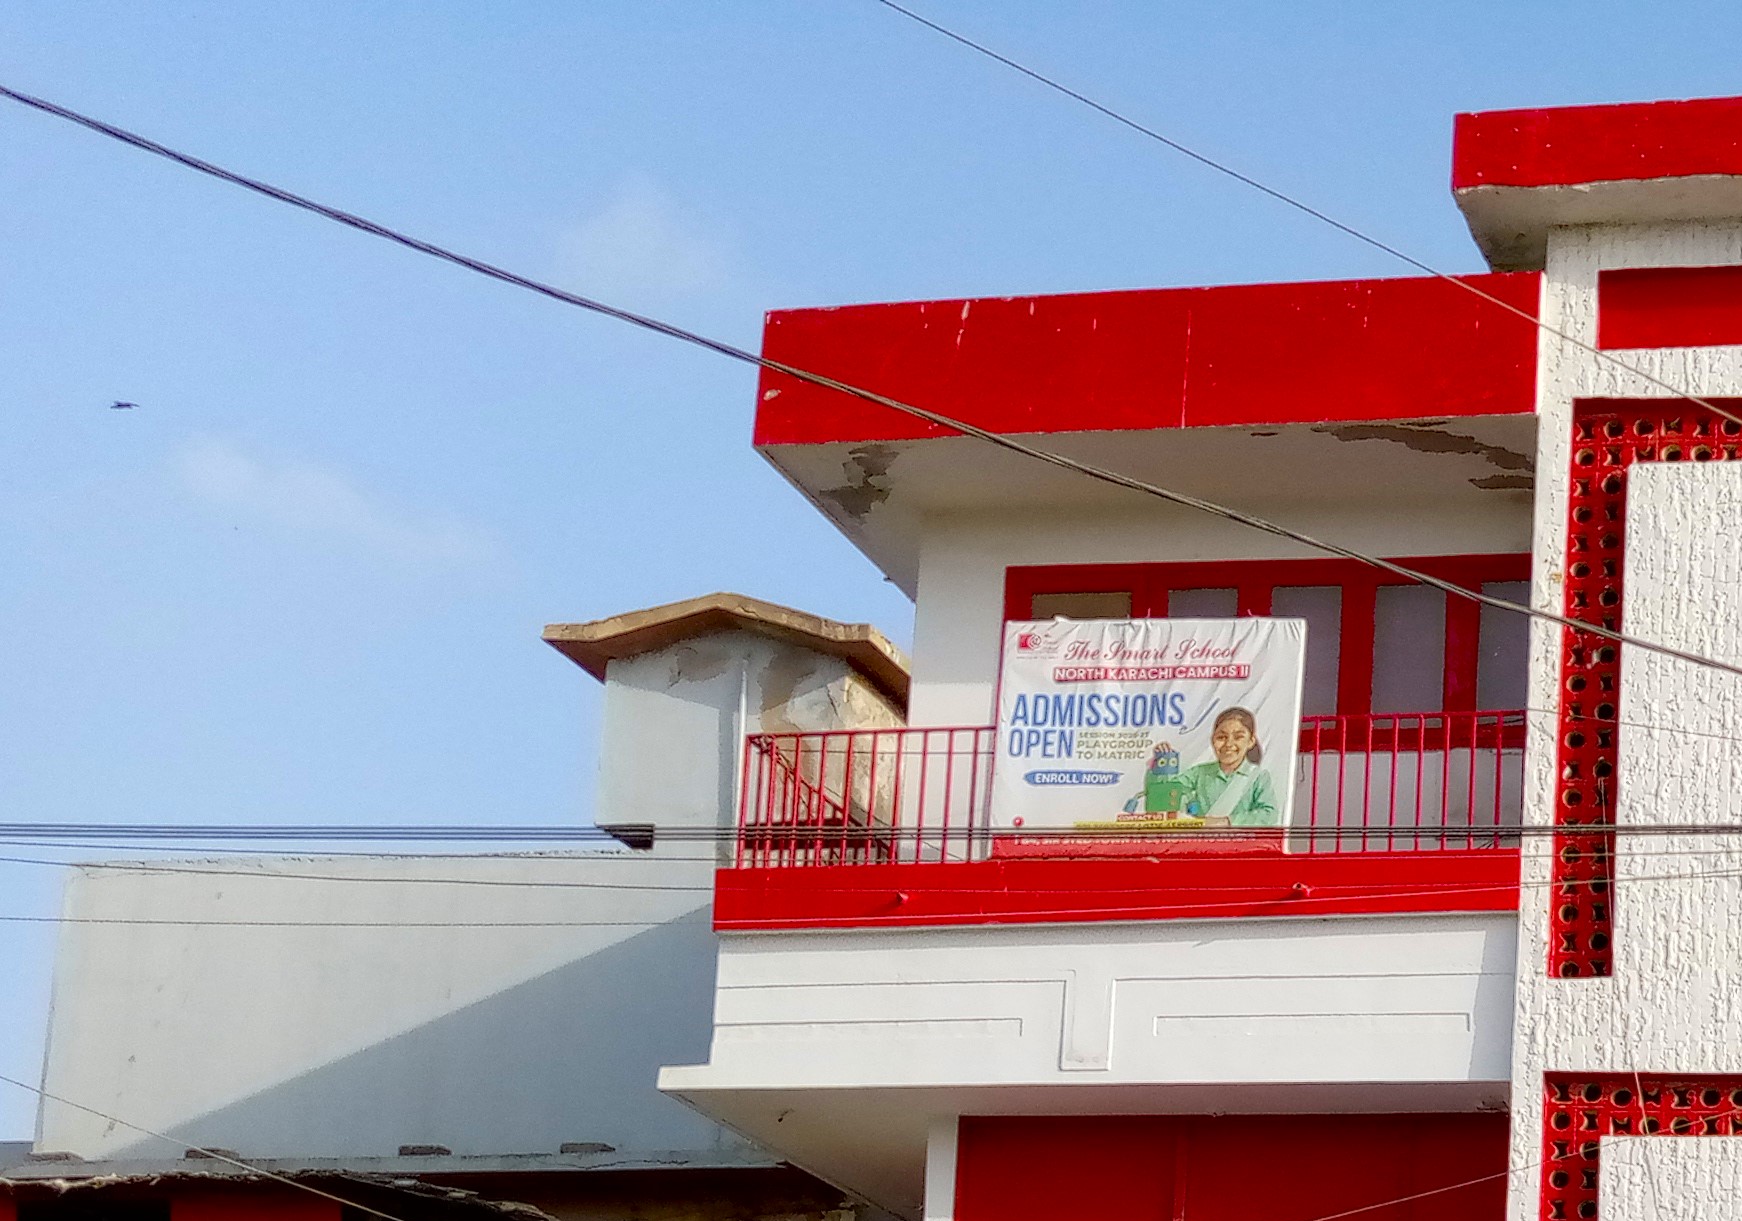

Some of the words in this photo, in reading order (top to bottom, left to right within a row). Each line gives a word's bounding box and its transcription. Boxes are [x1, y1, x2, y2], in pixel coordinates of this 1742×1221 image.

[1064, 640, 1100, 660] The
[1104, 640, 1171, 661] Smart
[1175, 638, 1244, 660] School
[1055, 668, 1105, 680] NORTH
[1108, 667, 1172, 680] KARACHI
[1175, 666, 1237, 678] CAMPUS
[1240, 665, 1249, 677] II
[1011, 692, 1185, 727] ADMISSIONS
[1009, 728, 1074, 758] OPEN
[1077, 740, 1153, 749] PLAYGROUP
[1076, 750, 1094, 760] TO
[1097, 750, 1145, 760] MATRIC
[1035, 773, 1080, 783] ENROLL
[1082, 773, 1112, 783] NOW!
